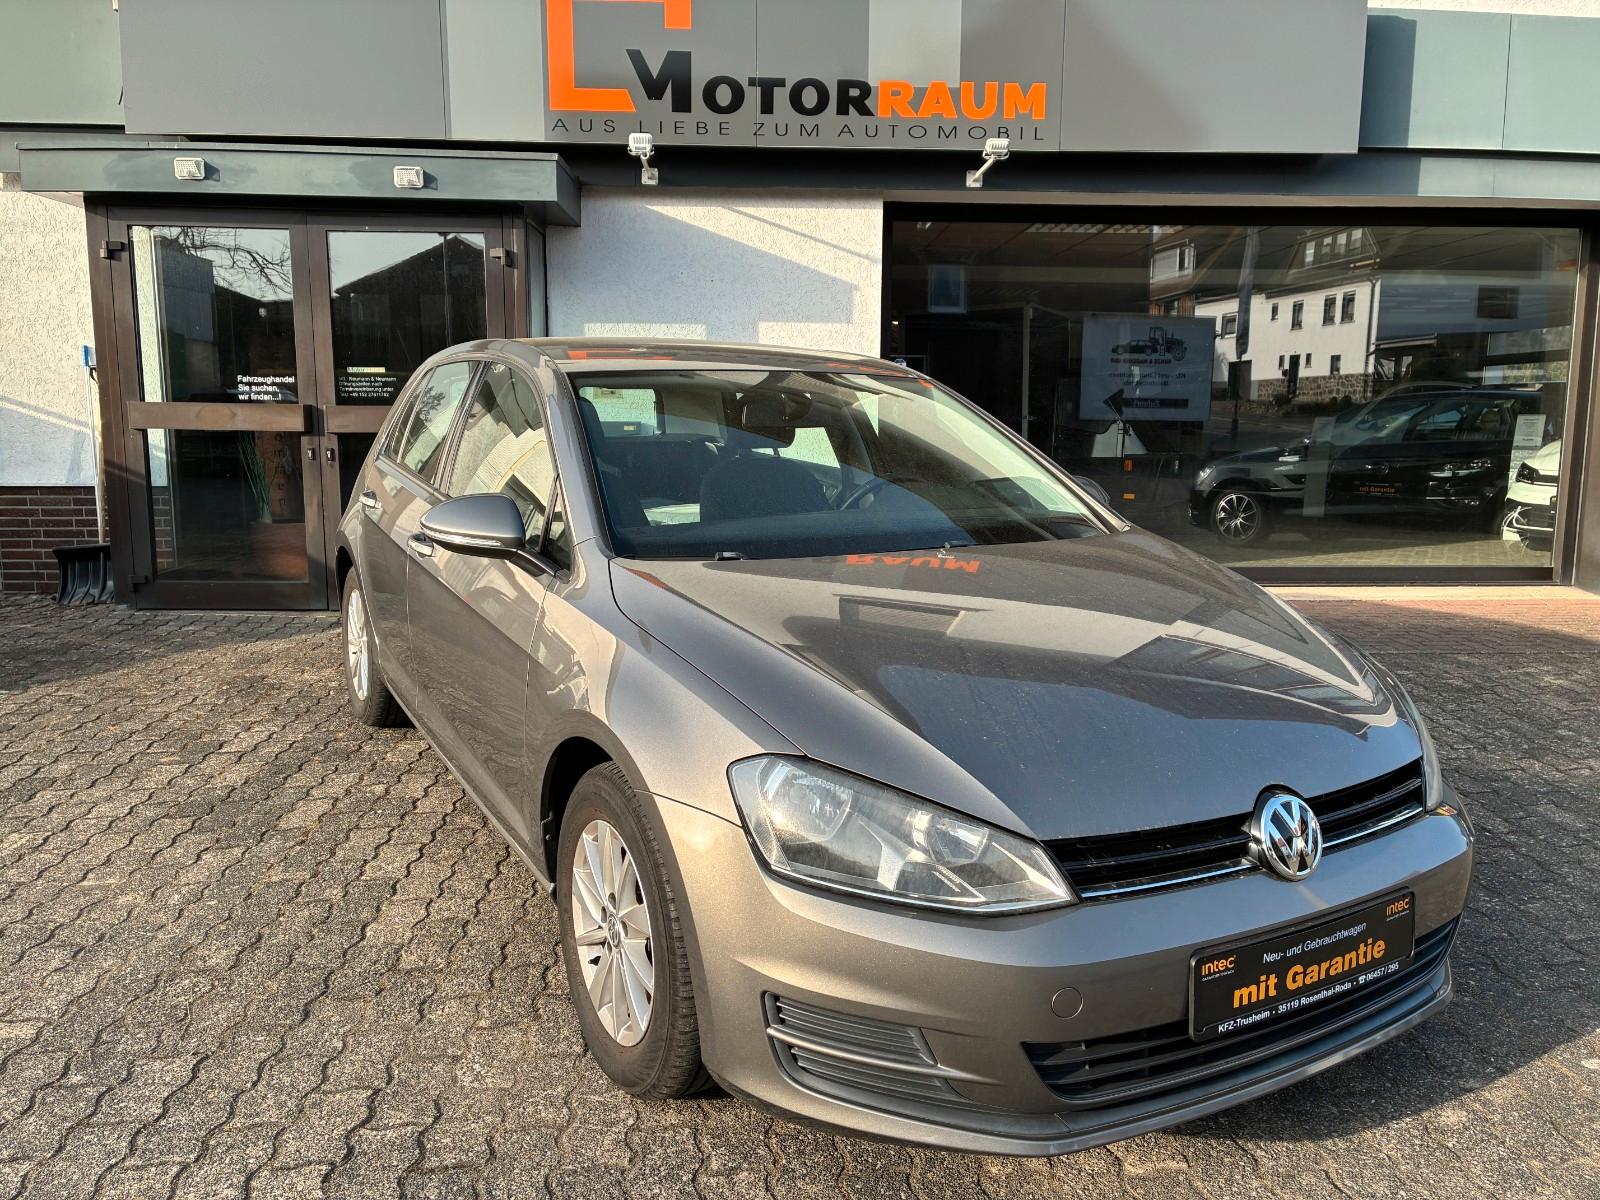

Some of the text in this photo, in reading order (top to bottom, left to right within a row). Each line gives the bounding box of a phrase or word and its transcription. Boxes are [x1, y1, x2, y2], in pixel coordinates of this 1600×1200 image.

[626, 49, 1047, 120] MOTORRAUM
[551, 118, 1044, 141] AUS LIEBE ZUM AUTOMOBIL
[237, 375, 295, 384] Fahrzeughandel
[251, 392, 282, 400] finden...!
[1263, 922, 1367, 964] Neu- und Gebrauchtwagen
[1233, 938, 1387, 1009] mit Garantie
[1218, 1010, 1270, 1033] KFZ-Trusheim
[1278, 999, 1299, 1014] 35119
[1300, 981, 1352, 1006] Rosenthal-Roda
